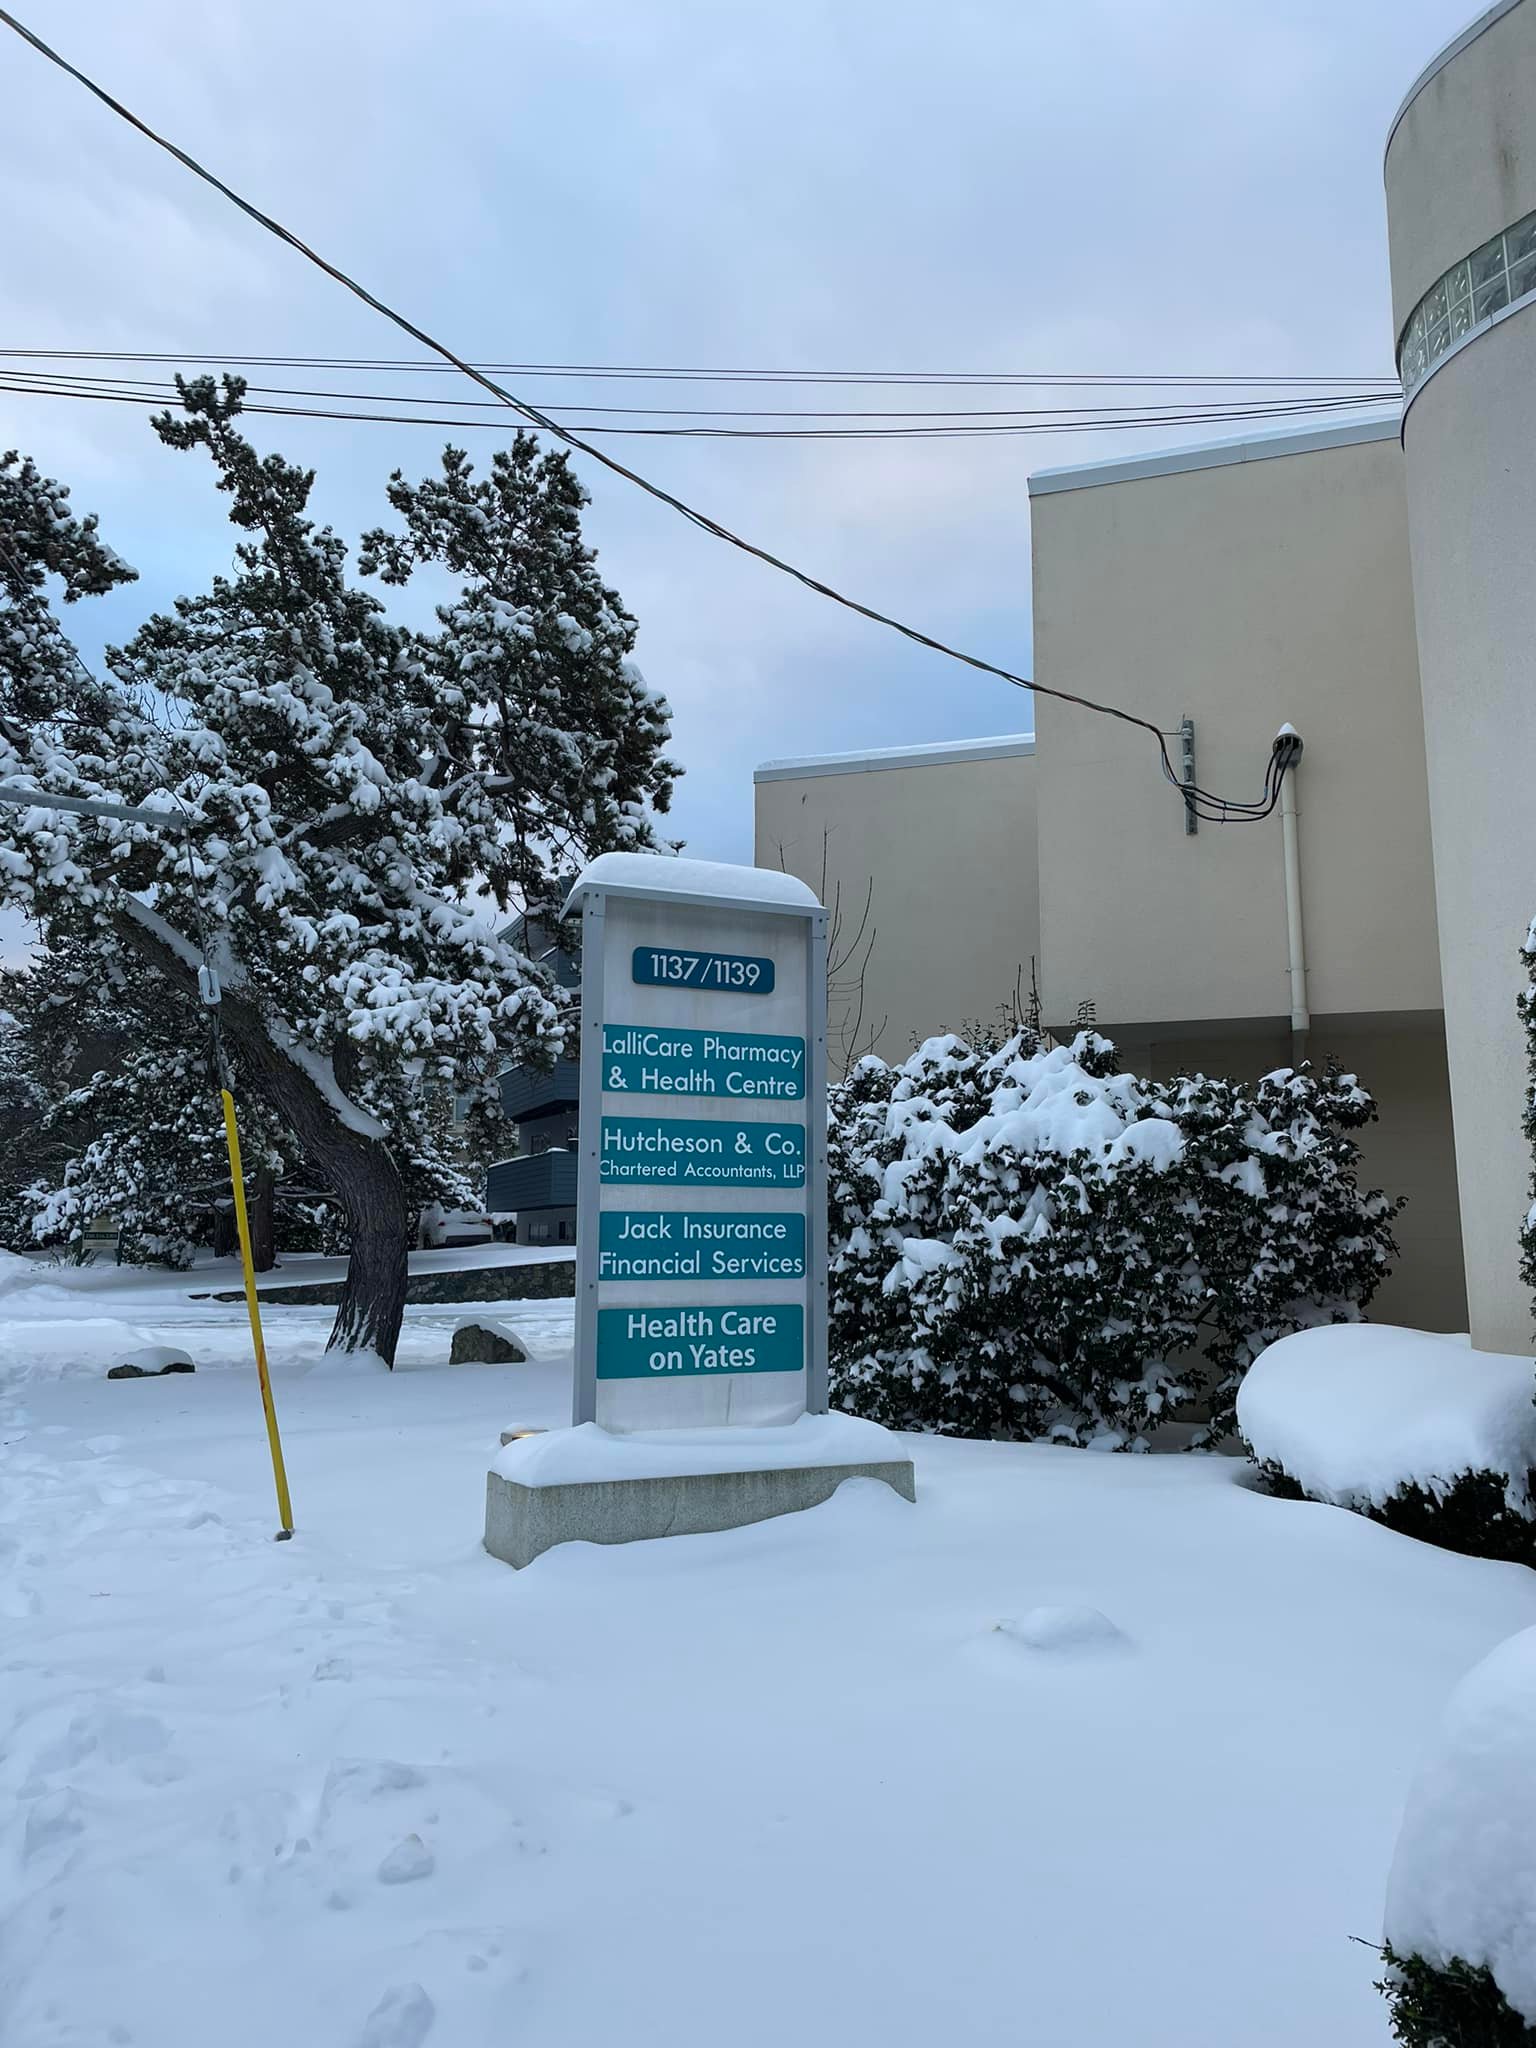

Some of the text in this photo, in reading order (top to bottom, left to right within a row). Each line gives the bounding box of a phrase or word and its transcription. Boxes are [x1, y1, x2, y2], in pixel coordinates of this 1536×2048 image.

[601, 1031, 803, 1070] LalliCare Pharmacy
[608, 1066, 798, 1097] & Health Centre
[603, 1128, 801, 1157] Hutcheson & Co.
[599, 1159, 805, 1180] Chartered Accountants, LLP
[618, 1215, 788, 1240] Jack Insurance
[598, 1250, 803, 1276] Financial Services
[627, 1311, 778, 1340] Health Care
[649, 1344, 756, 1372] on Yates
